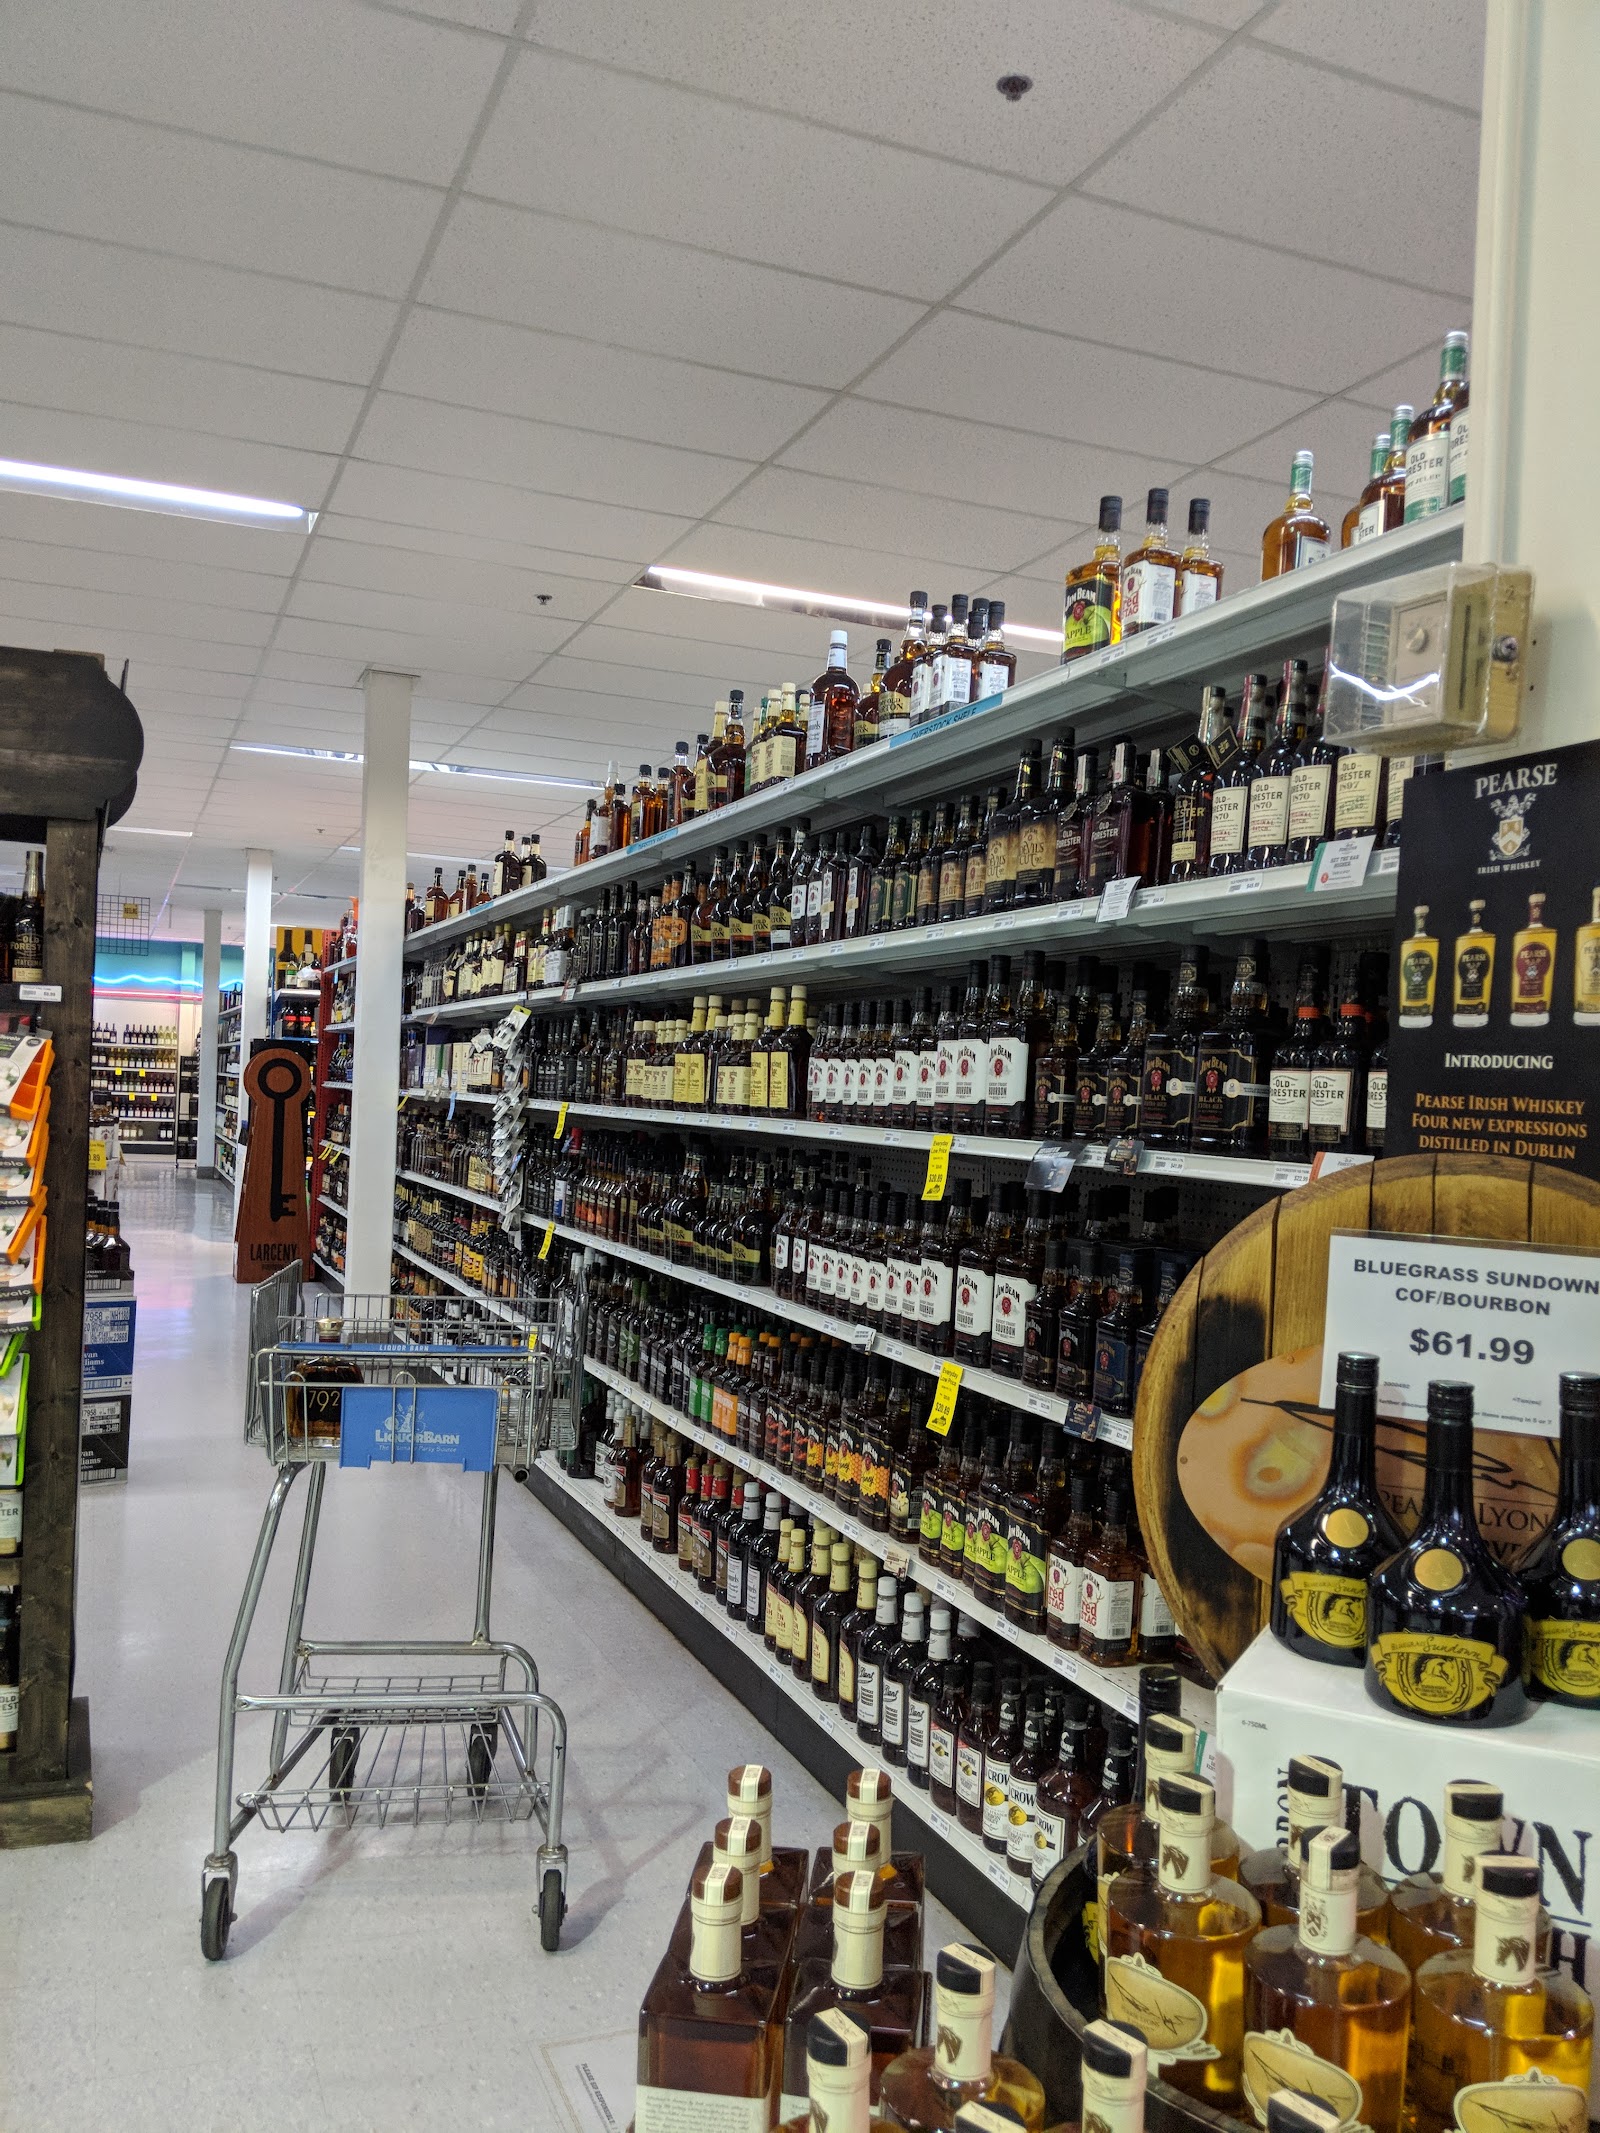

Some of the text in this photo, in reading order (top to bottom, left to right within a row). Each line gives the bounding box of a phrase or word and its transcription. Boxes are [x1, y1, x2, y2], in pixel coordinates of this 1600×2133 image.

[1410, 452, 1426, 464] OLD
[1077, 587, 1096, 603] BEAM
[1066, 625, 1092, 639] APPLE
[1342, 763, 1357, 772] OLD
[1295, 775, 1307, 783] OLD
[1475, 763, 1558, 799] PEARSE
[1215, 796, 1226, 804] OLD
[1099, 821, 1110, 830] OLD
[1062, 829, 1073, 839] OLD
[1092, 828, 1119, 841] FORESTER
[1477, 859, 1542, 875] IRISH WHISKEY
[22, 935, 40, 943] OLD
[1520, 949, 1547, 959] PEARSE
[998, 1044, 1012, 1063] BEAM
[1444, 1052, 1554, 1070] INTRODUCING
[1275, 1080, 1290, 1088] OLD
[1314, 1080, 1328, 1089] OLD
[1372, 1081, 1387, 1091] OLD
[1198, 1095, 1223, 1103] BLACK
[1415, 1093, 1585, 1115] PEARSE IRISH WHISKEY
[1412, 1112, 1588, 1138] FOUR NEW EXPRESSIONS
[1419, 1135, 1576, 1159] DISTILLED IN DUBLIN
[250, 1243, 297, 1261] LARCENY
[1353, 1258, 1600, 1295] BLUEGRASS SUNDOWN
[1005, 1283, 1021, 1303] BEAM
[1395, 1287, 1551, 1315] COF/BOURBON
[1409, 1328, 1535, 1364] $61.99
[942, 1366, 958, 1379] Everyday
[1501, 1414, 1524, 1423] ending
[985, 1507, 1000, 1534] BEAM
[1016, 1524, 1031, 1551] BEAM
[976, 1547, 996, 1561] APPLE
[1007, 1567, 1027, 1581] APPLE
[1049, 1586, 1065, 1603] red
[1082, 1599, 1097, 1618] red
[1421, 1636, 1482, 1659] Sundown
[1011, 1787, 1036, 1807] CROW
[1341, 1783, 1593, 1916] TON
